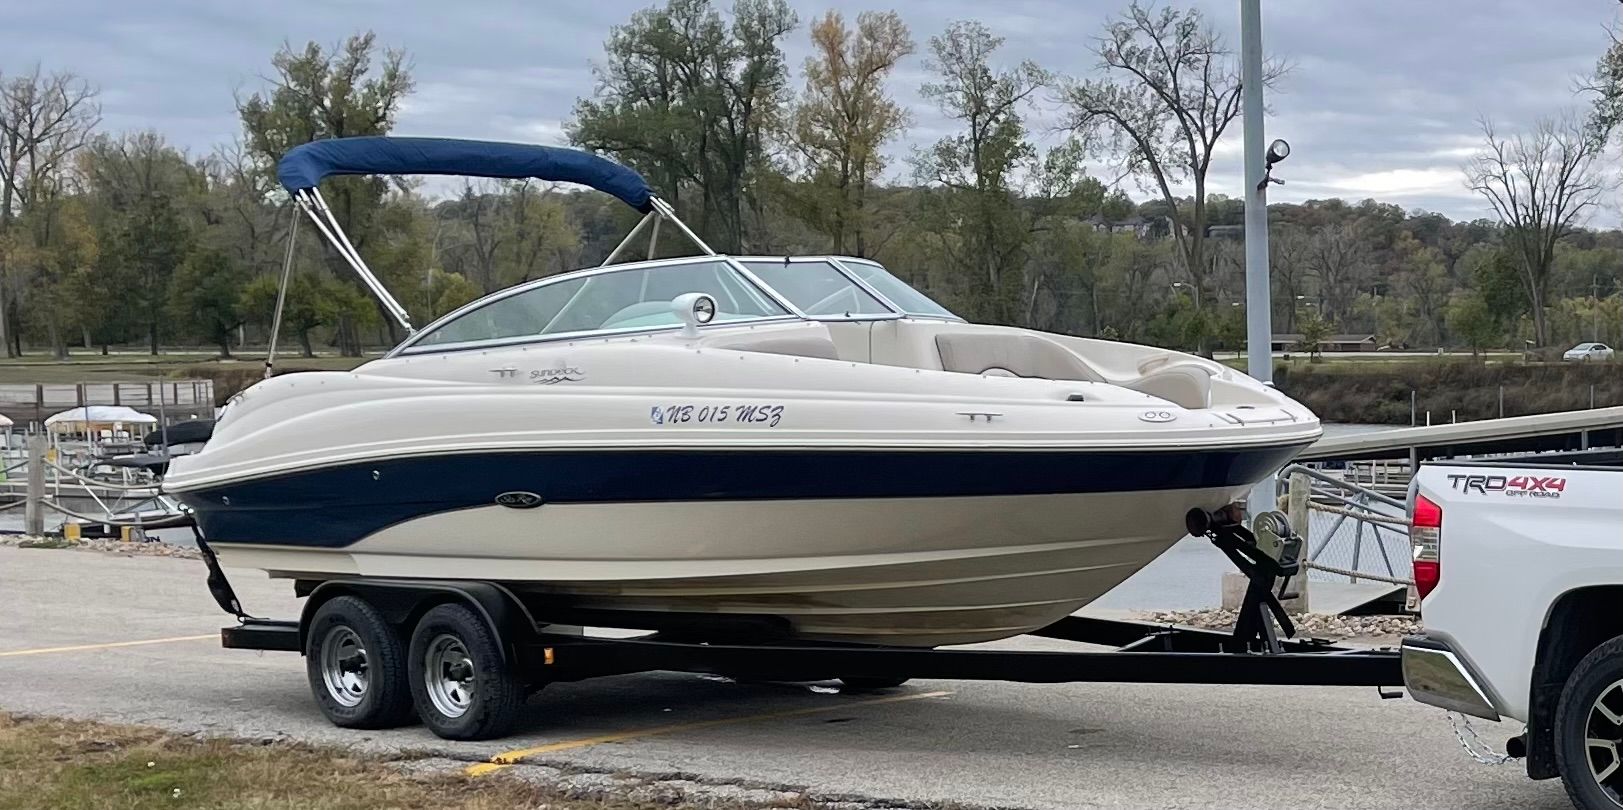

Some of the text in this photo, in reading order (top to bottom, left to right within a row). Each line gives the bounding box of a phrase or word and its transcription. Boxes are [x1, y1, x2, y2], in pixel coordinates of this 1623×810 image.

[666, 405, 694, 424] NB
[698, 405, 731, 423] 015
[735, 405, 785, 428] MSZ
[1447, 474, 1507, 495] TRD
[1529, 491, 1561, 499] ROAD
